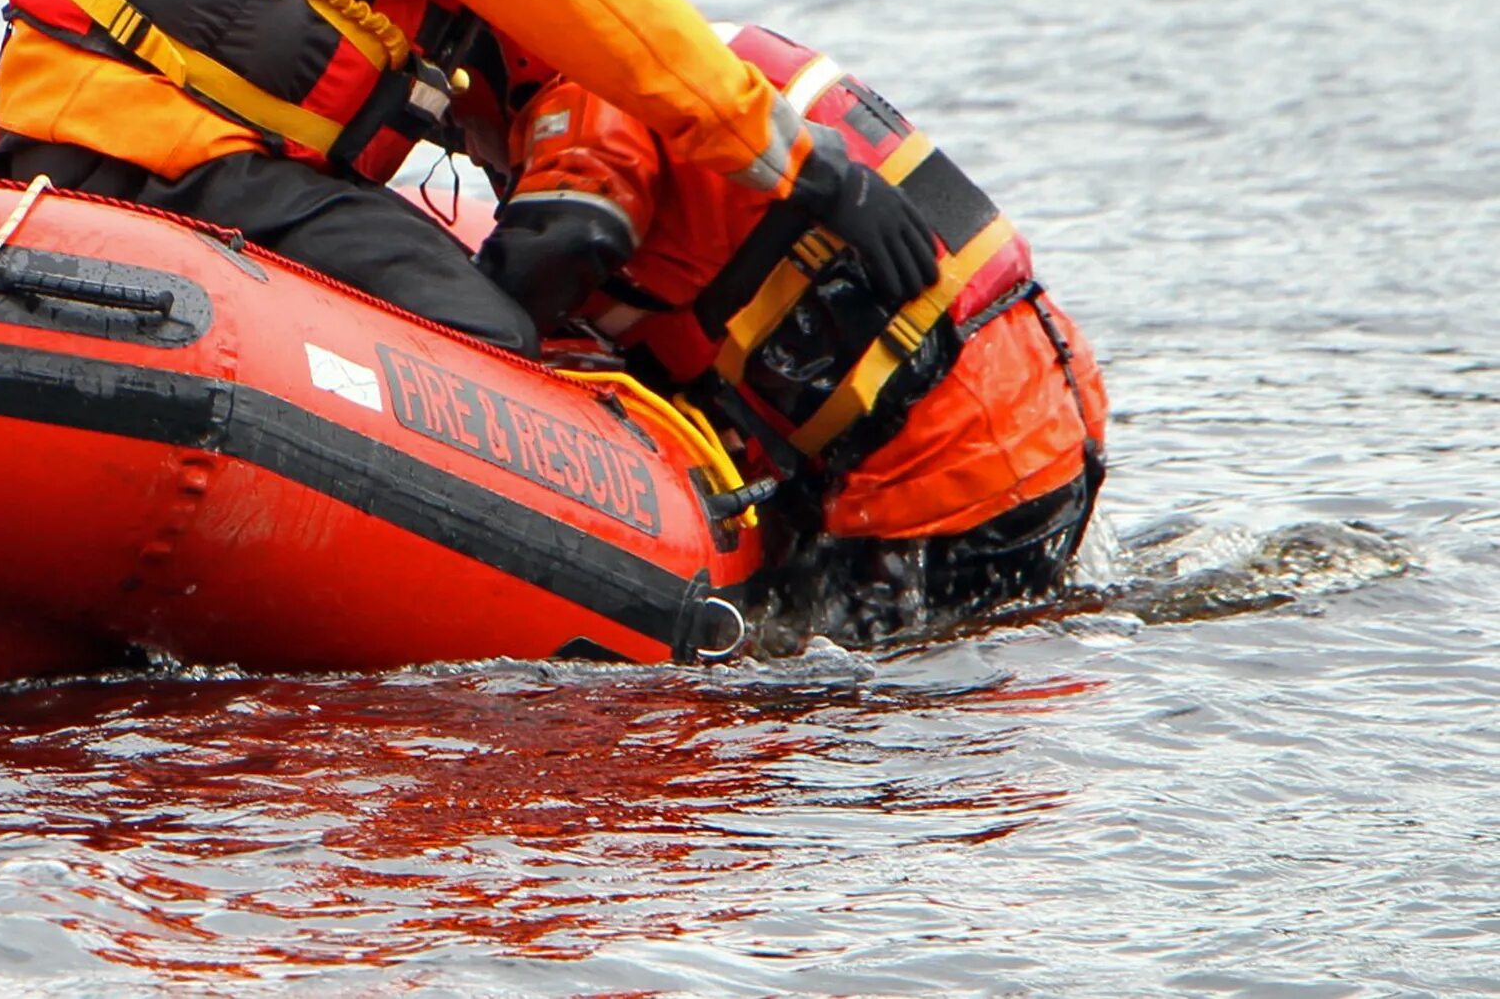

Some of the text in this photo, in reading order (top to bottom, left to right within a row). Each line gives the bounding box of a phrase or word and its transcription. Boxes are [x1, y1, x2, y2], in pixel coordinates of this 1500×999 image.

[389, 353, 652, 526] FIRE & RESCUE
